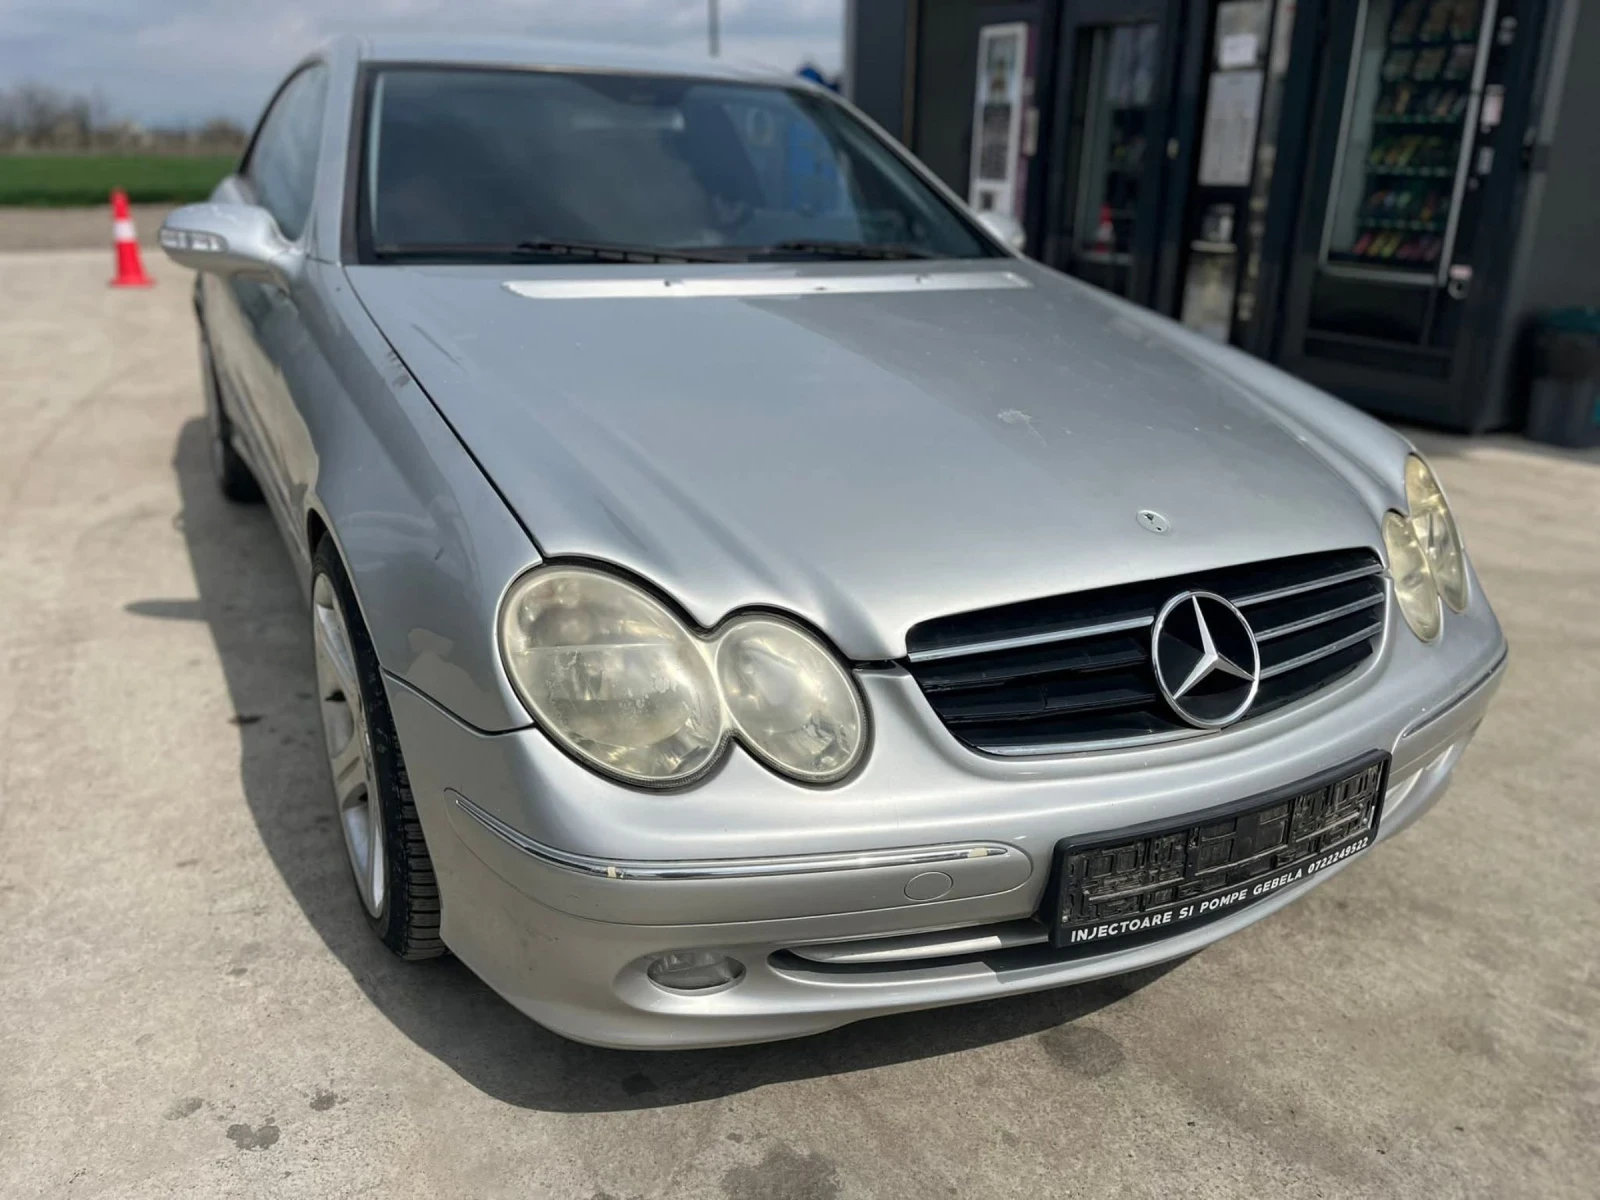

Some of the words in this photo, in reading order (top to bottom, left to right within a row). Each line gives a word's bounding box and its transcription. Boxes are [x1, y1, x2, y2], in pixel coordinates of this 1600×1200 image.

[1071, 911, 1172, 942] INJECTOARE
[1178, 905, 1194, 919] SI
[1199, 889, 1248, 913] POMPE
[1253, 868, 1303, 895] GEBELA
[1307, 836, 1369, 874] 0722249522
